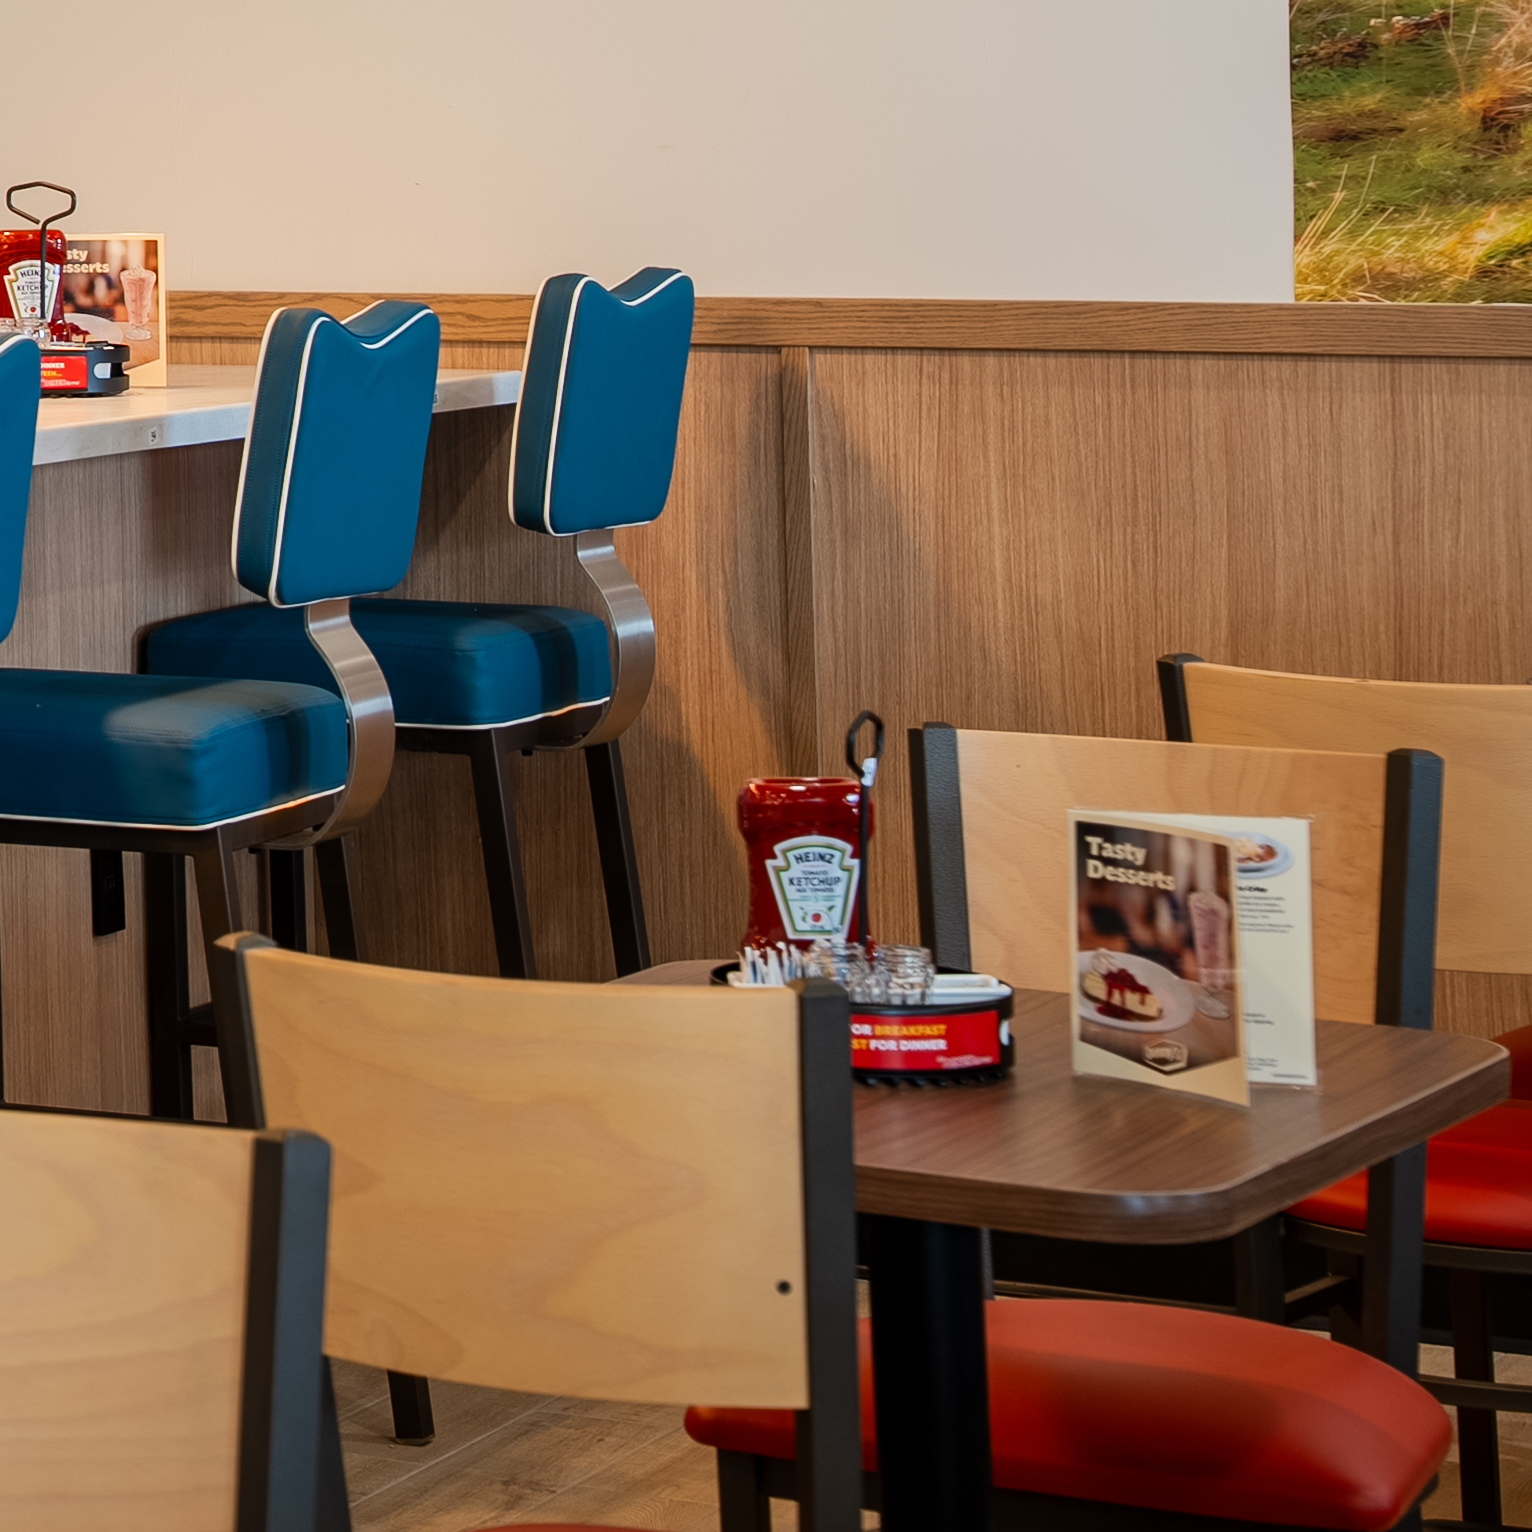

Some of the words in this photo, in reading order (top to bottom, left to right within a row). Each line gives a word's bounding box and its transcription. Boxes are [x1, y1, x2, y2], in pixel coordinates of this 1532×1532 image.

[66, 249, 88, 261] sty
[20, 269, 40, 278] HEIN
[63, 262, 110, 273] esserts
[1085, 836, 1147, 865] Tasty
[793, 852, 835, 864] HEINZ
[1086, 859, 1177, 891] Desserts
[788, 876, 842, 887] KETCHUP
[850, 1023, 873, 1035] OR
[873, 1024, 947, 1036] BREAKFAST
[869, 1039, 898, 1051] FOR
[898, 1039, 948, 1051] DINNER
